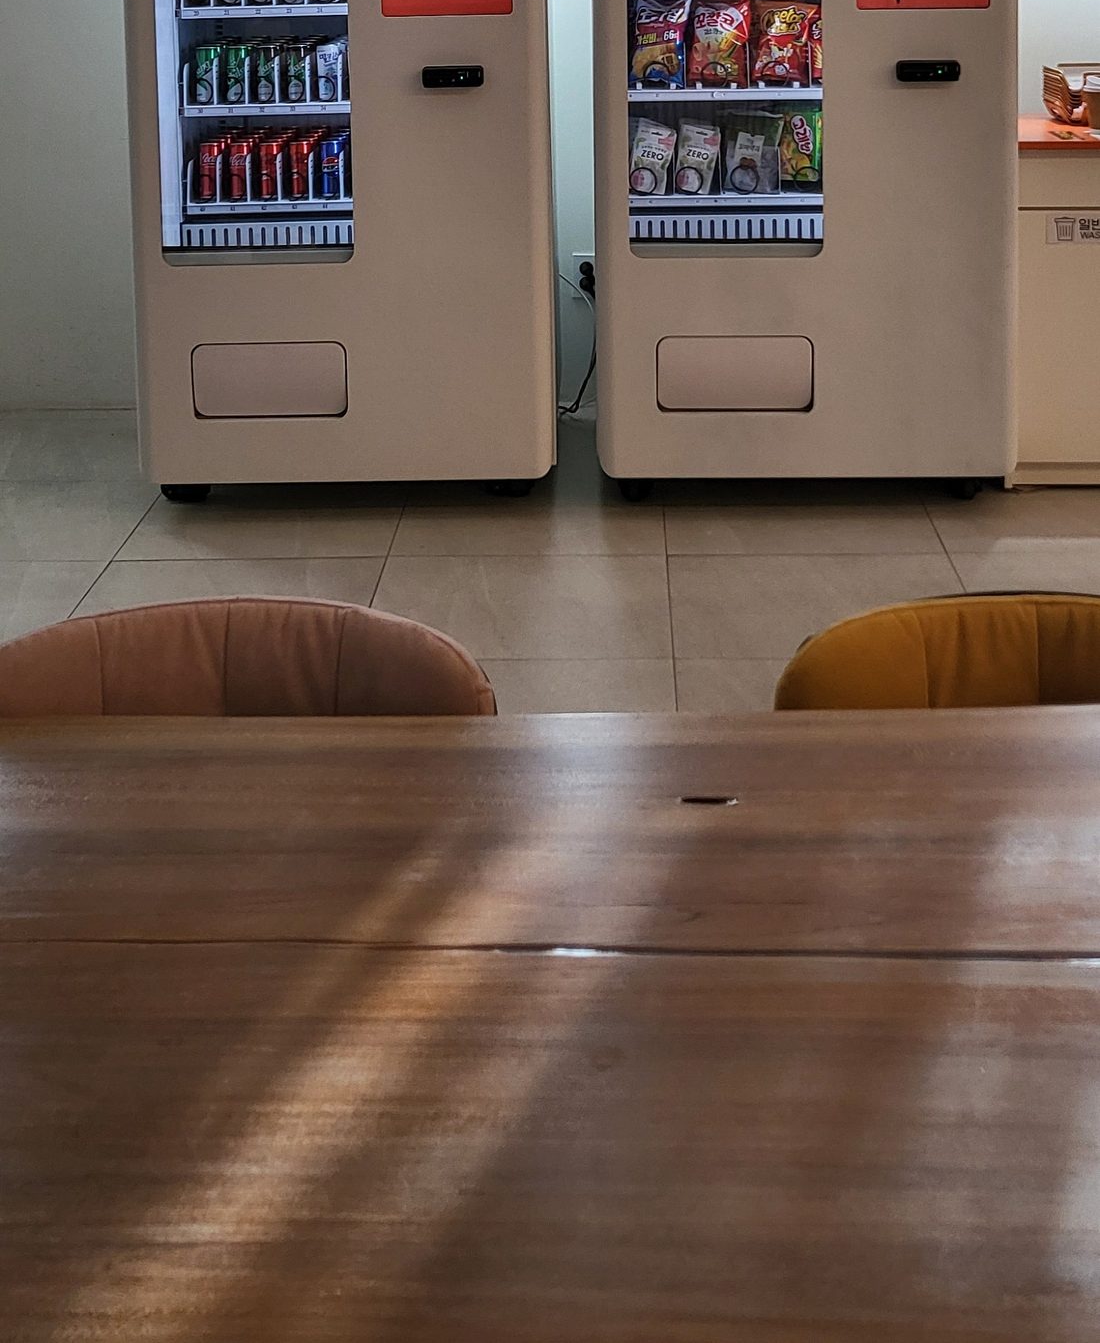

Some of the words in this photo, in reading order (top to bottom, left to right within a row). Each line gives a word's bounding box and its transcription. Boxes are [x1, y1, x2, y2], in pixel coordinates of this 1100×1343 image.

[792, 118, 812, 153] 고래밥
[641, 149, 665, 161] ZERO
[686, 148, 709, 161] ZERO
